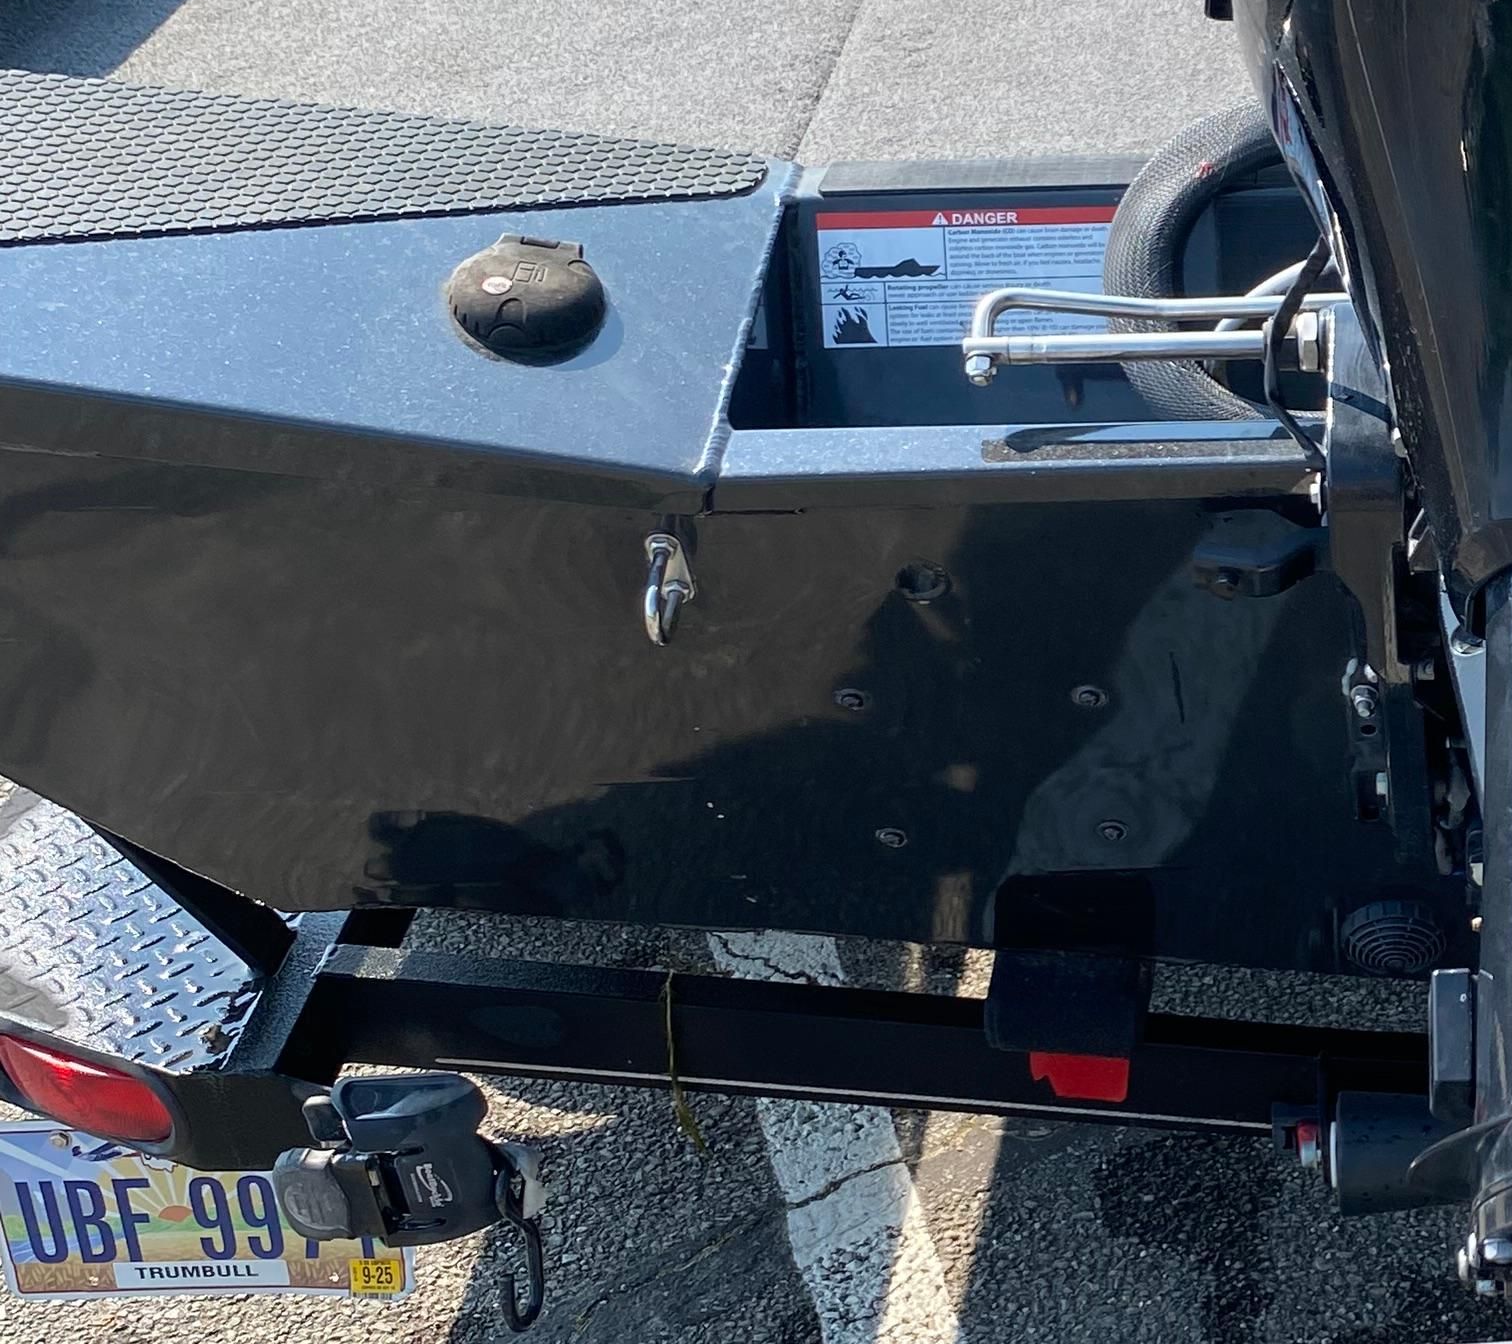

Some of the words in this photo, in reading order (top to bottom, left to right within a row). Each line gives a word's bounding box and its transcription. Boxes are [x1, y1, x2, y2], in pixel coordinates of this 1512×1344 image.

[951, 211, 1018, 225] DANGER
[15, 1176, 154, 1264] UBF
[189, 1174, 376, 1261] 99
[134, 1264, 260, 1280] TRUMBULL
[362, 1266, 393, 1285] 9-25
